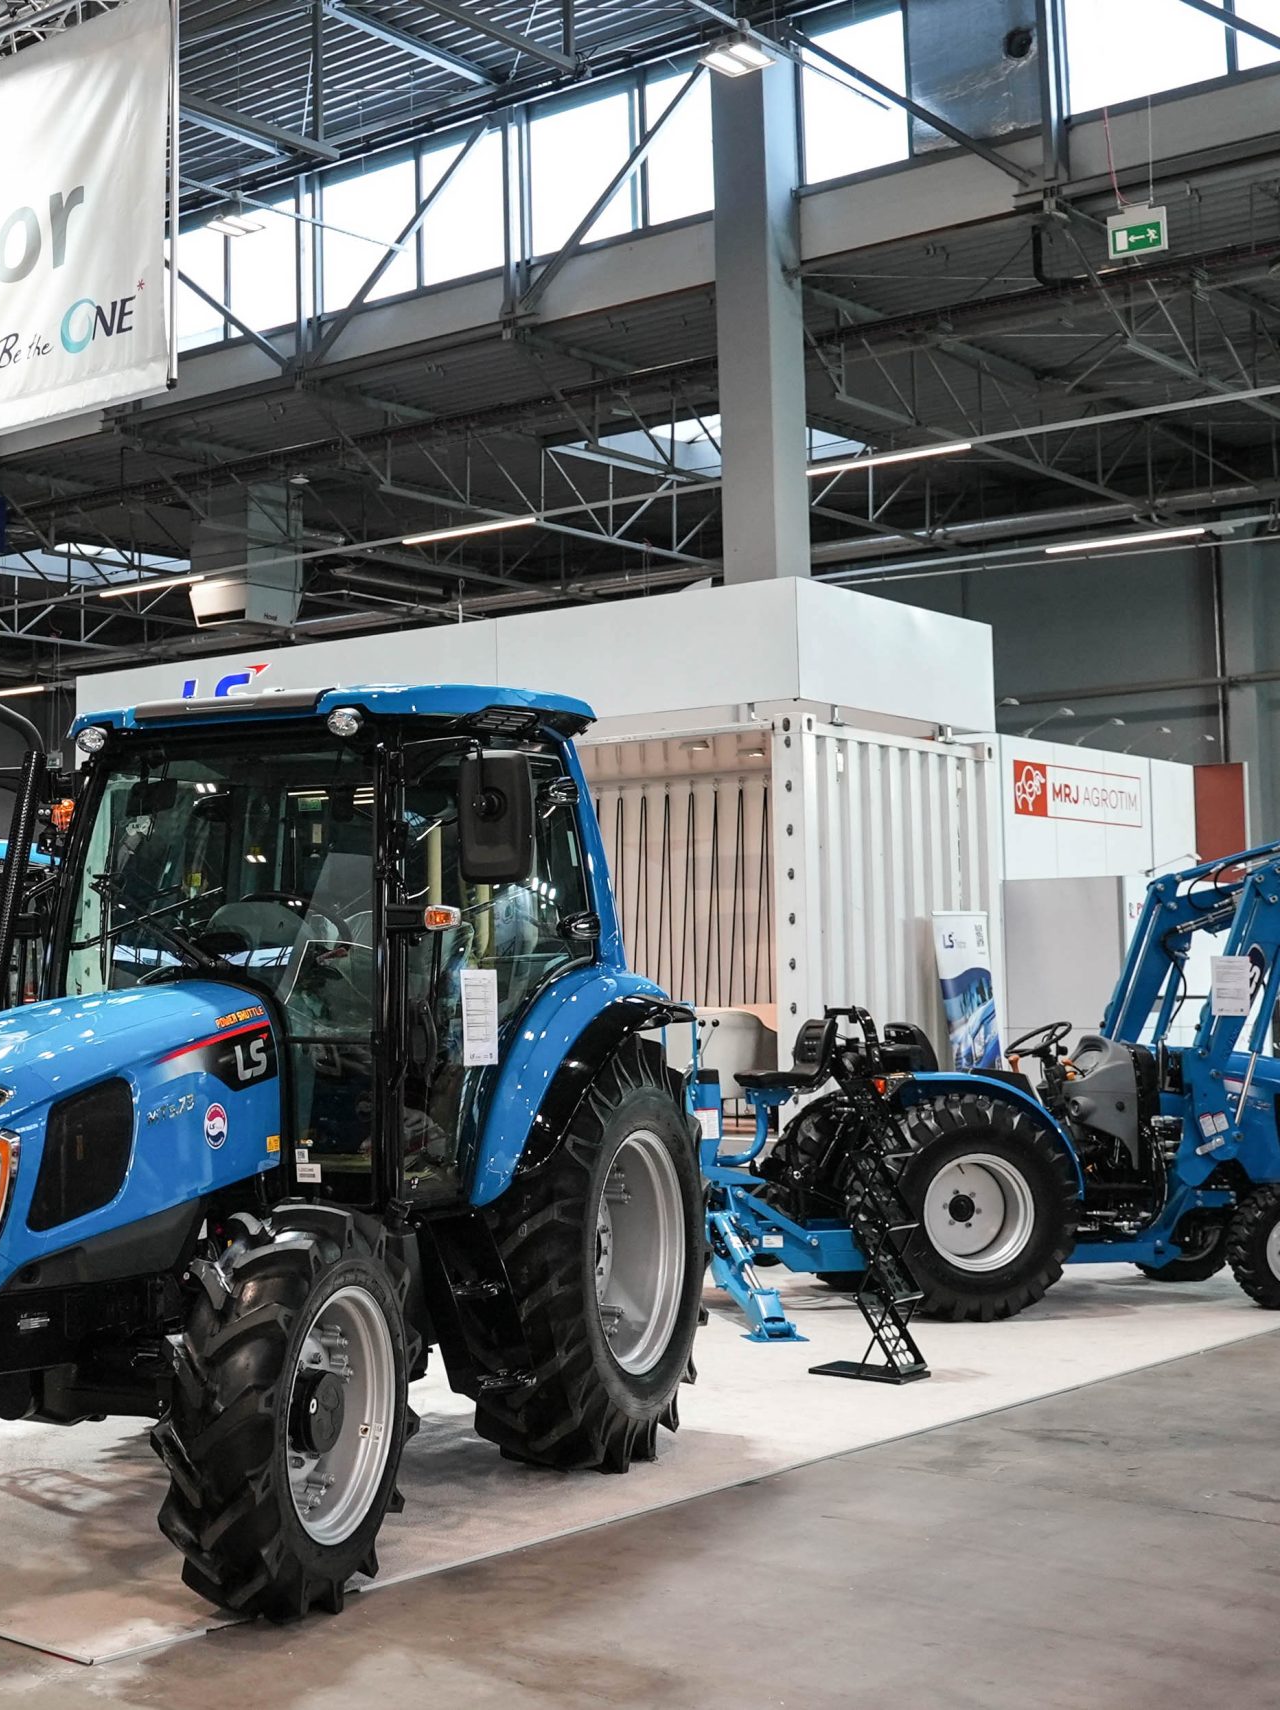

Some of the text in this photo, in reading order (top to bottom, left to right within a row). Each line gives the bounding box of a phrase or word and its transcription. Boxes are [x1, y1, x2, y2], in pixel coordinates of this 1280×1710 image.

[26, 333, 55, 360] the
[60, 297, 137, 354] ONE
[1052, 782, 1139, 812] MRJ AGROTIM
[234, 1038, 268, 1082] LS
